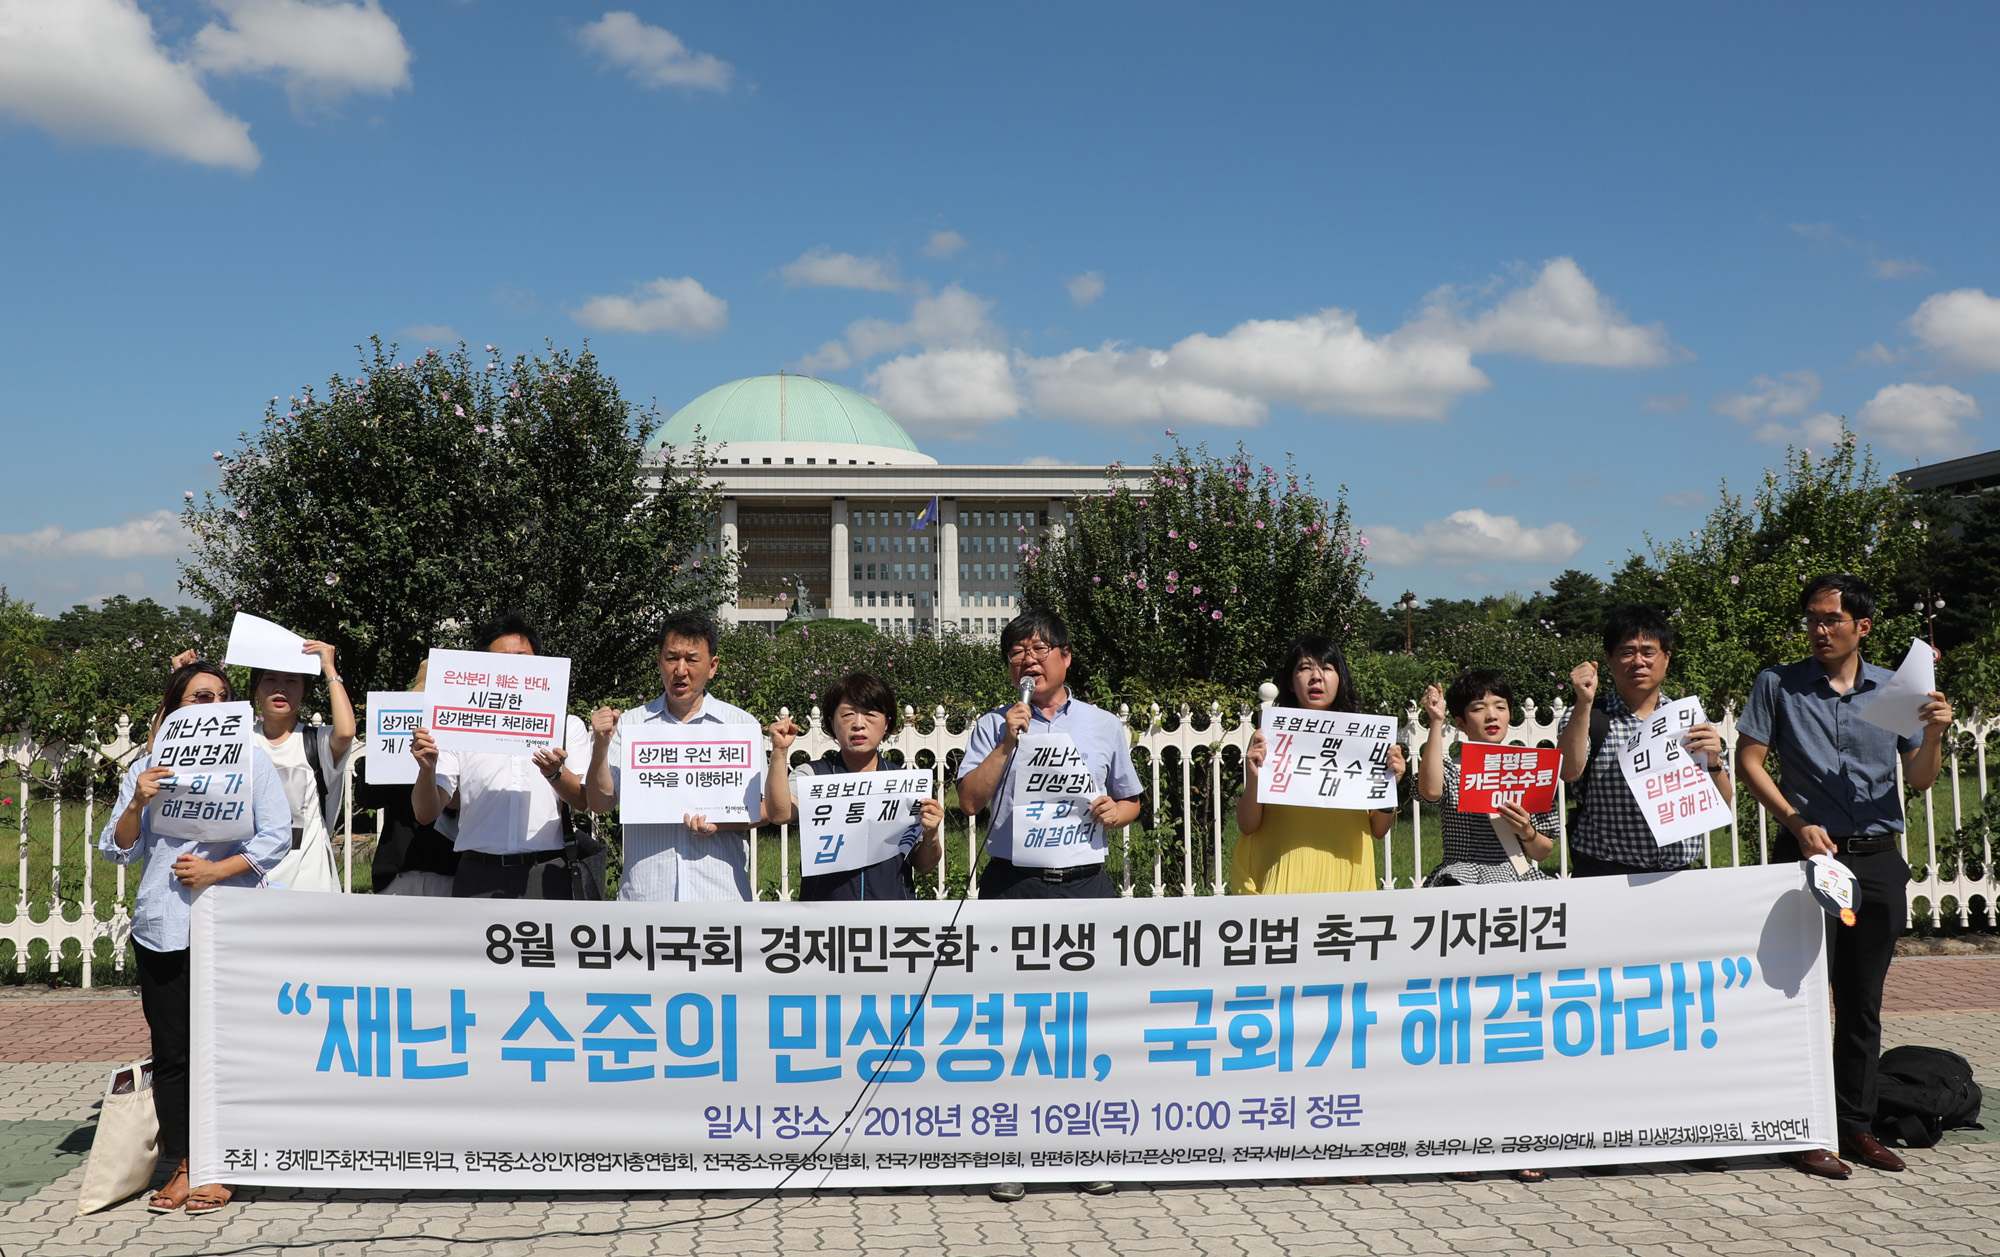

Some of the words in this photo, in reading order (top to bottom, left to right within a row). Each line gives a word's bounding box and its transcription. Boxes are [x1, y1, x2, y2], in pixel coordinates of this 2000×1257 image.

[443, 670, 490, 687] 은산분리
[495, 673, 519, 689] 훼손
[524, 676, 550, 692] 반대,
[468, 691, 523, 710] 시/급/한
[162, 715, 243, 742] 재난수준
[382, 715, 423, 731] 상가임
[438, 711, 496, 728] 상가법부터
[502, 715, 548, 733] 처리하라
[1271, 715, 1336, 734] 폭염보다
[1345, 722, 1391, 739] 무서운
[158, 743, 243, 767] 민생경제
[638, 747, 678, 764] 상가법
[684, 747, 711, 763] 우선
[718, 746, 744, 762] 처리
[1027, 746, 1086, 767] 재난수
[1484, 752, 1538, 771] 불평등
[638, 772, 679, 788] 약속을
[685, 771, 743, 788] 이행하라!
[809, 780, 873, 798] 폭염보다
[883, 778, 929, 794] 무서운
[1464, 769, 1554, 791] 카드수수료
[1645, 763, 1707, 800] 입법으로
[161, 799, 244, 820] 해결하라
[1491, 790, 1526, 808] OUT
[1023, 823, 1097, 848] 해결하라
[485, 920, 556, 968] 8월
[570, 923, 743, 973] 임시국회
[1112, 919, 1201, 968] 10대
[1217, 915, 1298, 966] 입법
[1312, 914, 1397, 962] 촉구
[1410, 902, 1567, 958] 기자회견
[277, 981, 476, 1080] “재난
[500, 990, 738, 1083] 수준의
[768, 991, 1112, 1083] 민생경제,
[1143, 981, 1378, 1077] 국회가
[1398, 956, 1753, 1067] 해결하라!”
[703, 1104, 762, 1140] 일시
[771, 1105, 832, 1139] 장소
[863, 1104, 962, 1138] 2018년
[971, 1102, 1019, 1137] 8월
[1030, 1099, 1140, 1136] 16일(목)
[1151, 1100, 1231, 1131] 10:00
[1238, 1095, 1296, 1130] 국회
[1306, 1093, 1364, 1128] 정문
[223, 1148, 257, 1171] 주최
[275, 1149, 459, 1173] 경제민주화전국네트워크,
[464, 1150, 698, 1173] 한국중소상인자영업자총연합회,
[702, 1152, 870, 1172] 전국중소유통상인협회,
[875, 1151, 1026, 1170] 전국가맹점주협의회,
[1030, 1147, 1227, 1168] 맘편히장사하고픈상인모임,
[1232, 1140, 1409, 1163] 전국서비스산업노조연맹,
[1414, 1137, 1496, 1157] 청년유니온,
[1501, 1132, 1596, 1154] 금융정의연대,
[1602, 1129, 1633, 1148] 민변
[1751, 1117, 1810, 1141] 참여연대
